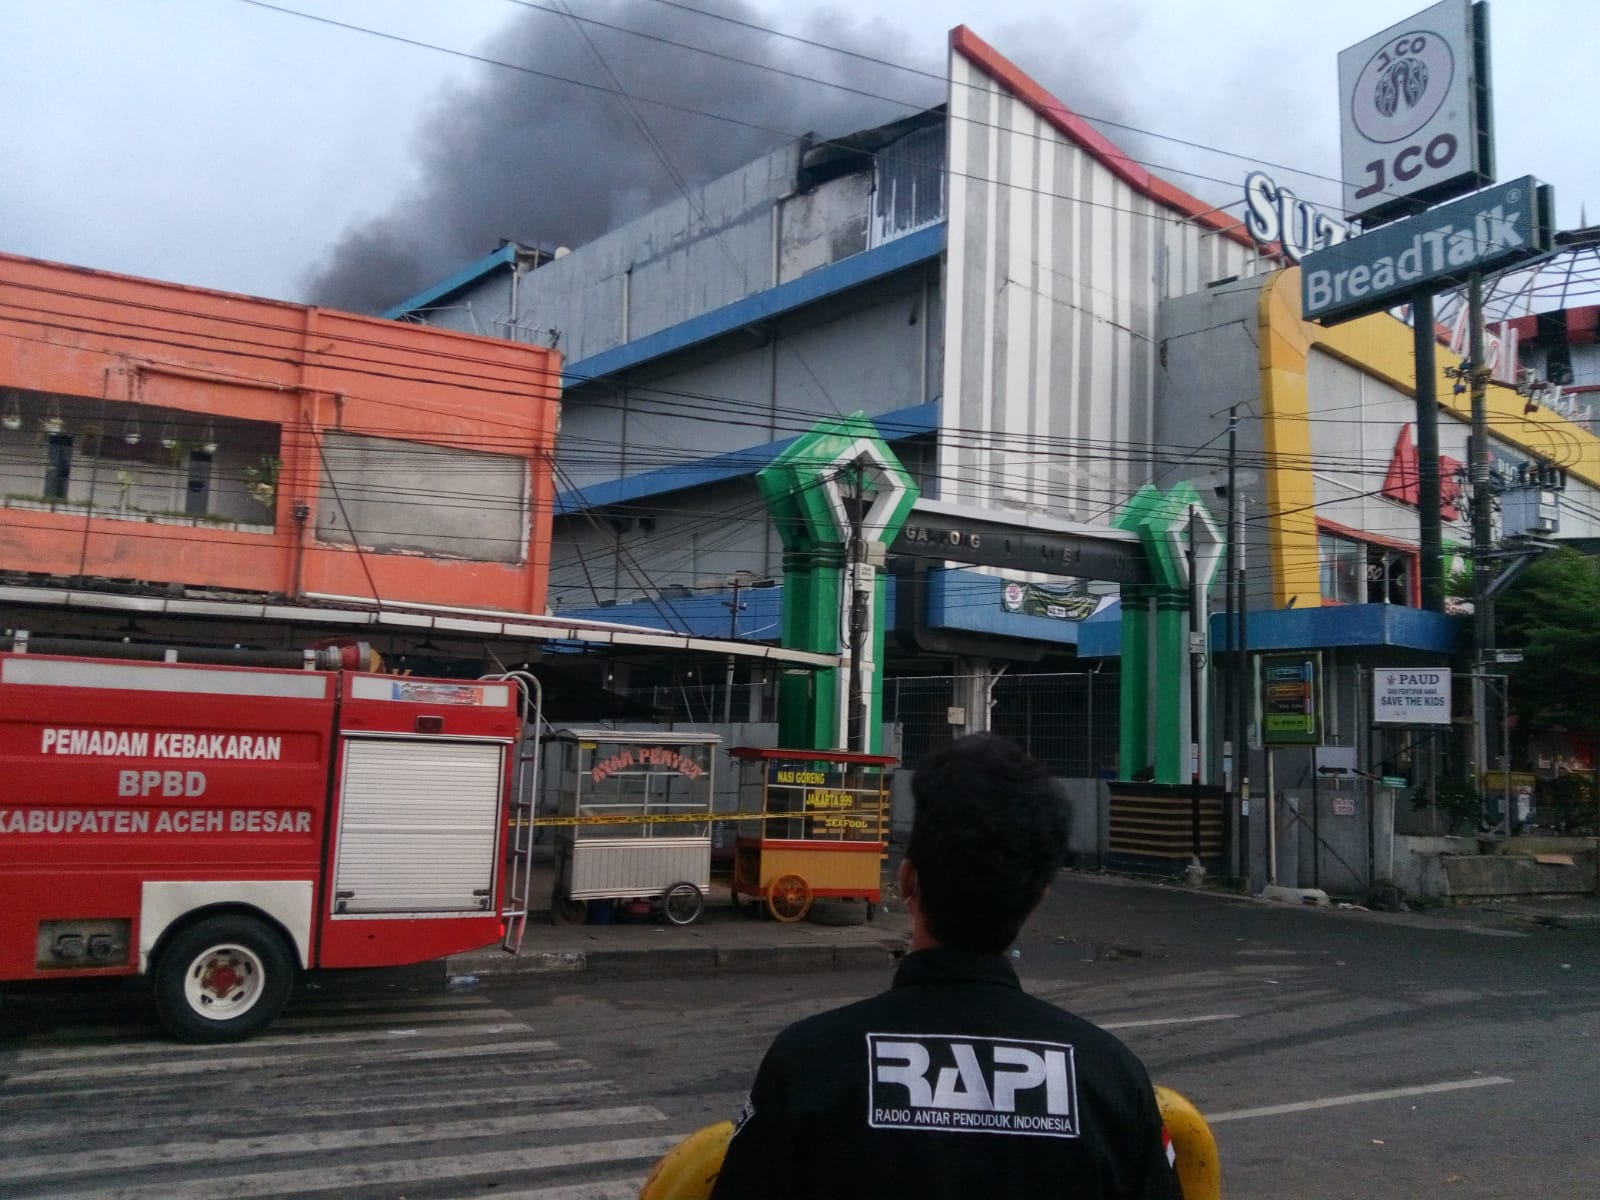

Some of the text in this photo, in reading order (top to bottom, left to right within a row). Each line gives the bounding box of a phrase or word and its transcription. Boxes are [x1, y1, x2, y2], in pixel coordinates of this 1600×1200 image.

[1308, 205, 1525, 312] BreadTalk
[1399, 674, 1440, 685] PAUD
[1381, 696, 1446, 707] SAVE THE KIDS
[41, 728, 282, 761] PEMADAM KEBAKARAN
[118, 770, 207, 798] BPBD
[777, 771, 825, 785] NASI GORENG
[806, 793, 853, 807] JAKARTA 999
[154, 810, 224, 833] ACEH
[229, 810, 312, 833] BESAR
[875, 1041, 1070, 1116] RAPI
[875, 1108, 1073, 1132] RADIO ANTAR PENDUDUK INDONESIA
